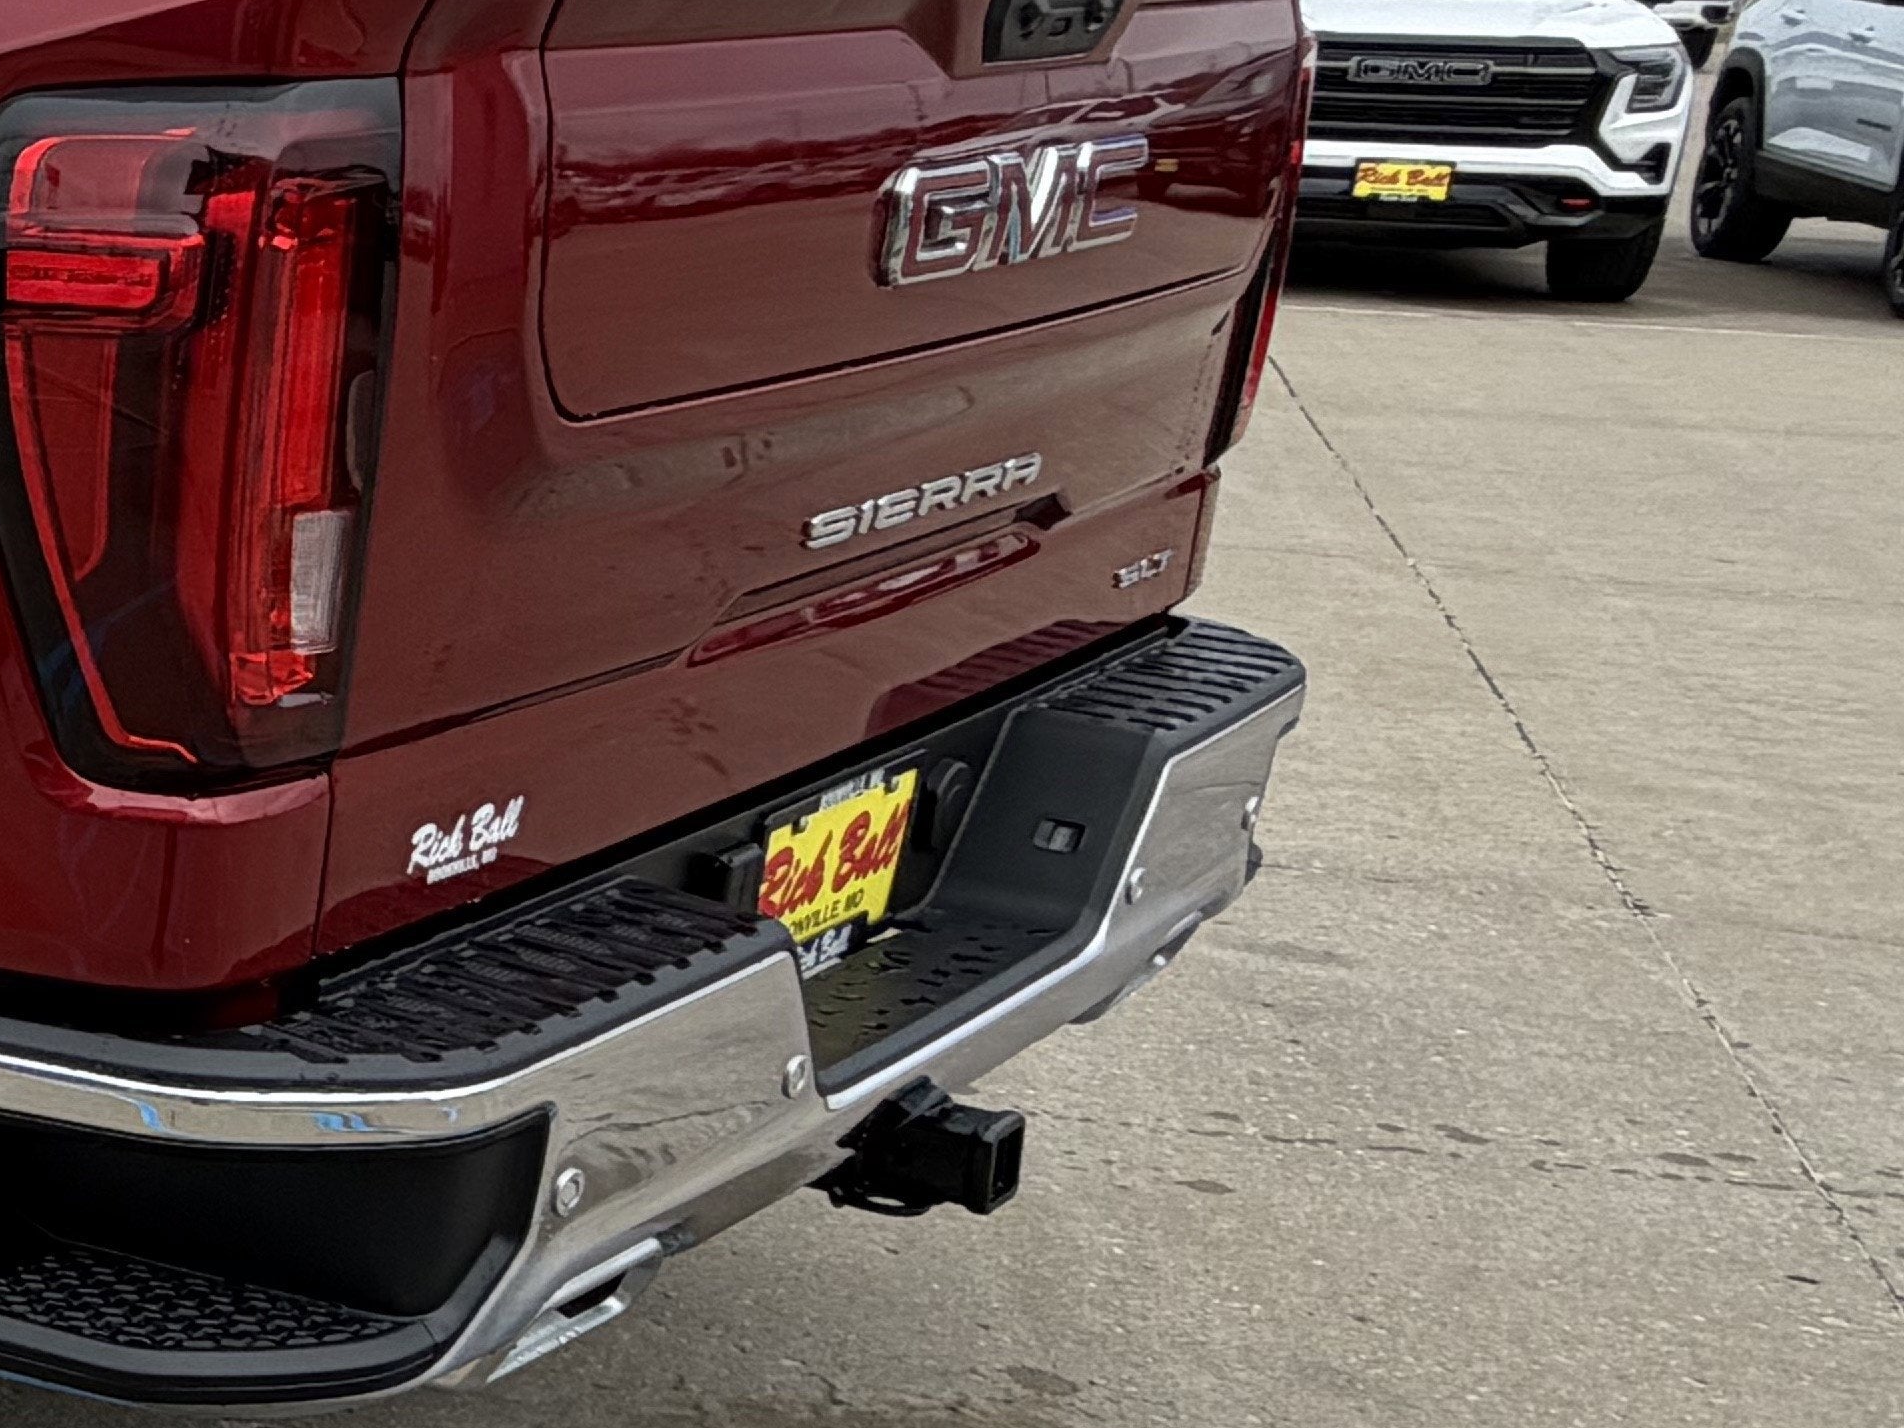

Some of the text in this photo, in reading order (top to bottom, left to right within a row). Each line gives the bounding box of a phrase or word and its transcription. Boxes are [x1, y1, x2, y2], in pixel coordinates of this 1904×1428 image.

[1357, 58, 1490, 83] GMC
[878, 132, 1149, 285] GMC
[799, 452, 1042, 549] SIERRA
[1112, 548, 1174, 588] SLT
[406, 814, 466, 875] Rick
[470, 795, 524, 851] Ball
[757, 798, 913, 919] Rick Ball
